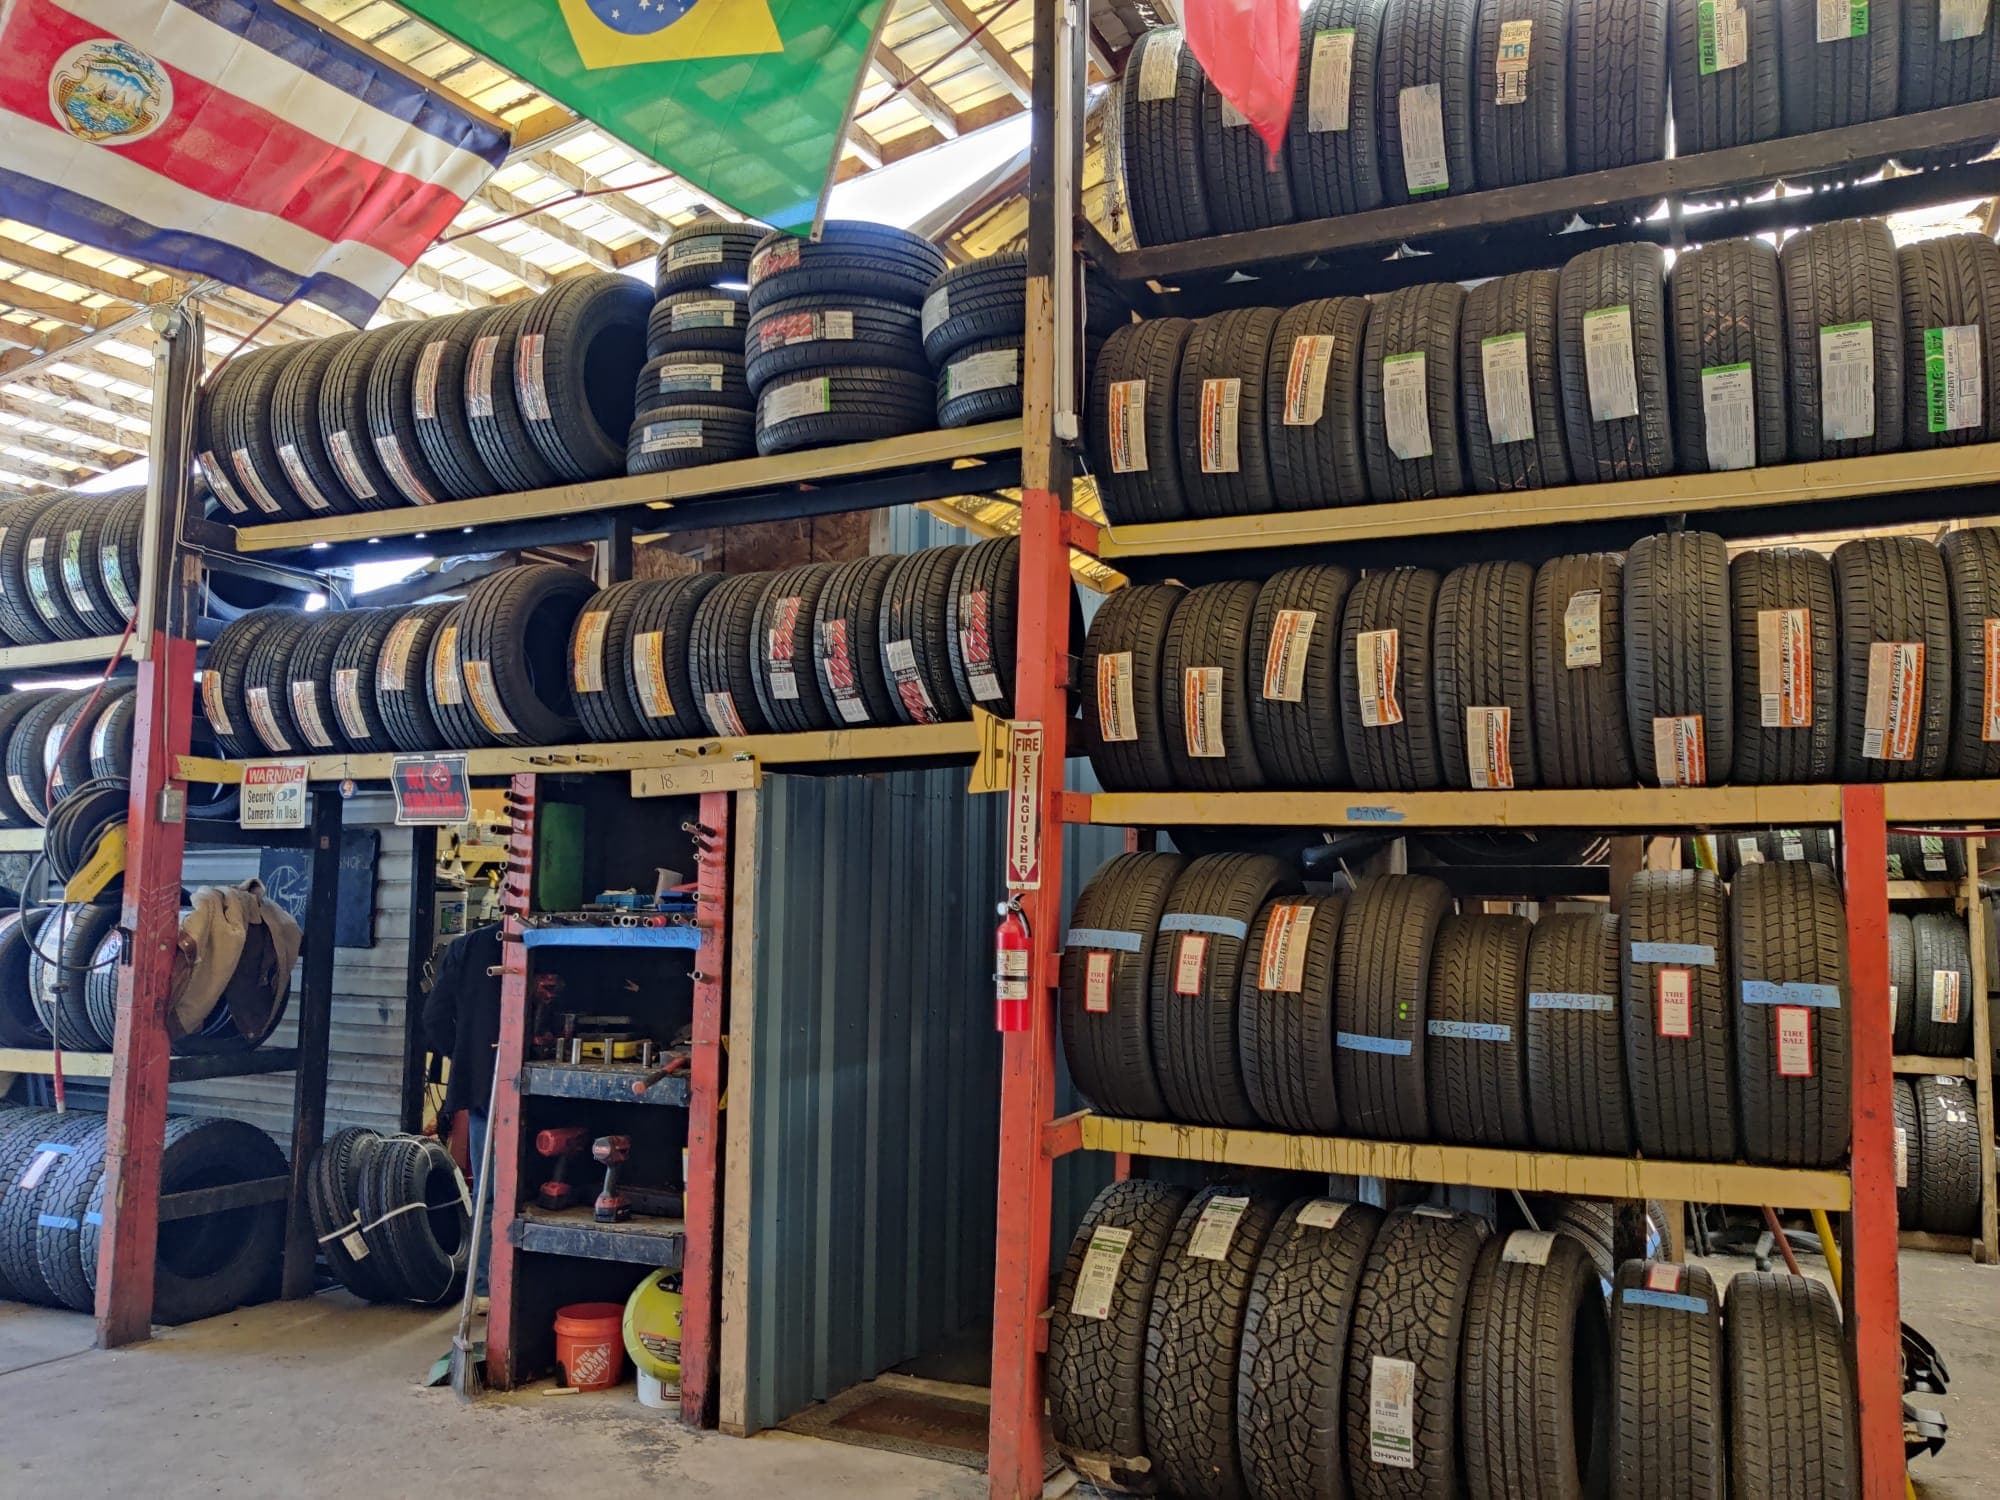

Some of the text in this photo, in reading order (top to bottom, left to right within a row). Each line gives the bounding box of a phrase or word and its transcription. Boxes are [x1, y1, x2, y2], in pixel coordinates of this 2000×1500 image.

[1503, 43, 1525, 59] TR
[1932, 371, 1944, 425] DELINTE
[1792, 629, 1803, 718] ARROYO
[1898, 666, 1913, 752] ARROYO
[1015, 737, 1039, 752] FIRE
[249, 768, 302, 784] WARNING
[700, 769, 714, 785] 21
[247, 790, 275, 805] Security
[403, 791, 466, 816] SMOKING
[247, 805, 298, 820] Cameras In Use
[1019, 754, 1031, 874] EXTINGUISHER
[1534, 993, 1608, 1010] 235-45-17
[1431, 1021, 1505, 1039] 235-45-17
[1782, 1037, 1806, 1045] SALE
[571, 1344, 610, 1383] HOME
[1374, 1451, 1411, 1464] KUMHO
